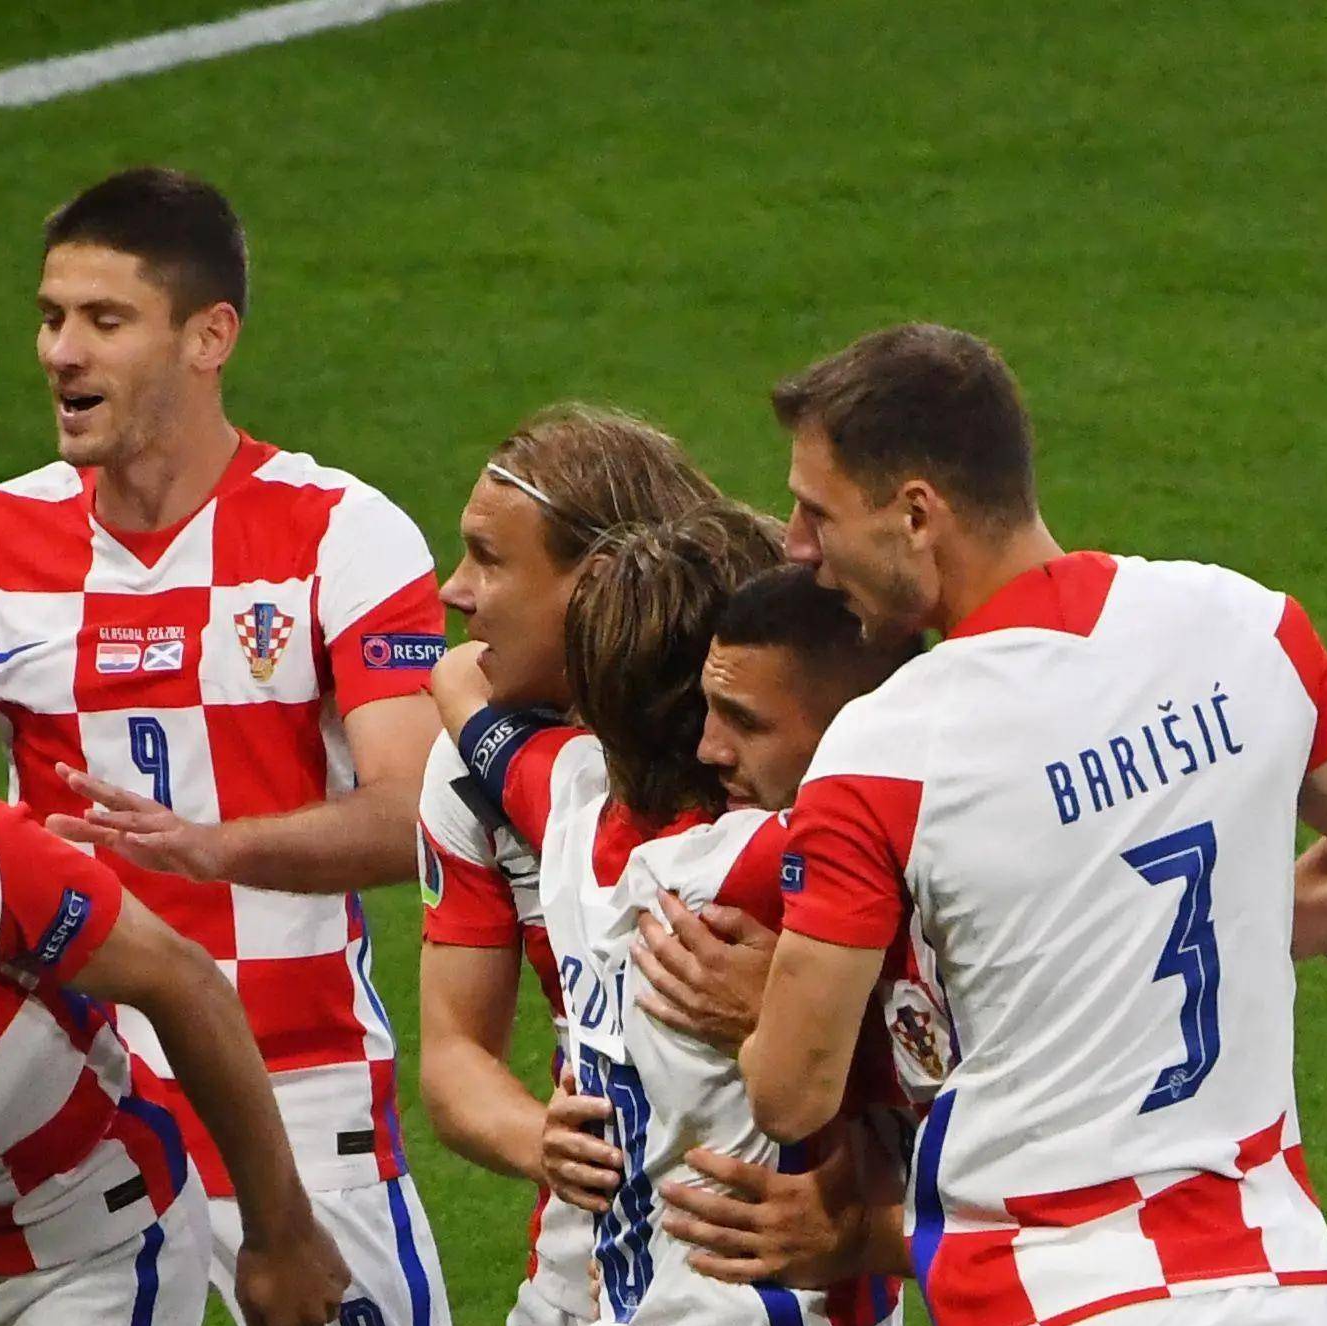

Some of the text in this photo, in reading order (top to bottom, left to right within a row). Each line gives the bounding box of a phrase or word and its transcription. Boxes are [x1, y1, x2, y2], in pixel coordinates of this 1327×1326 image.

[128, 717, 173, 811] 9
[1046, 682, 1243, 825] BARIŠIĆ
[1120, 820, 1217, 1115] 3
